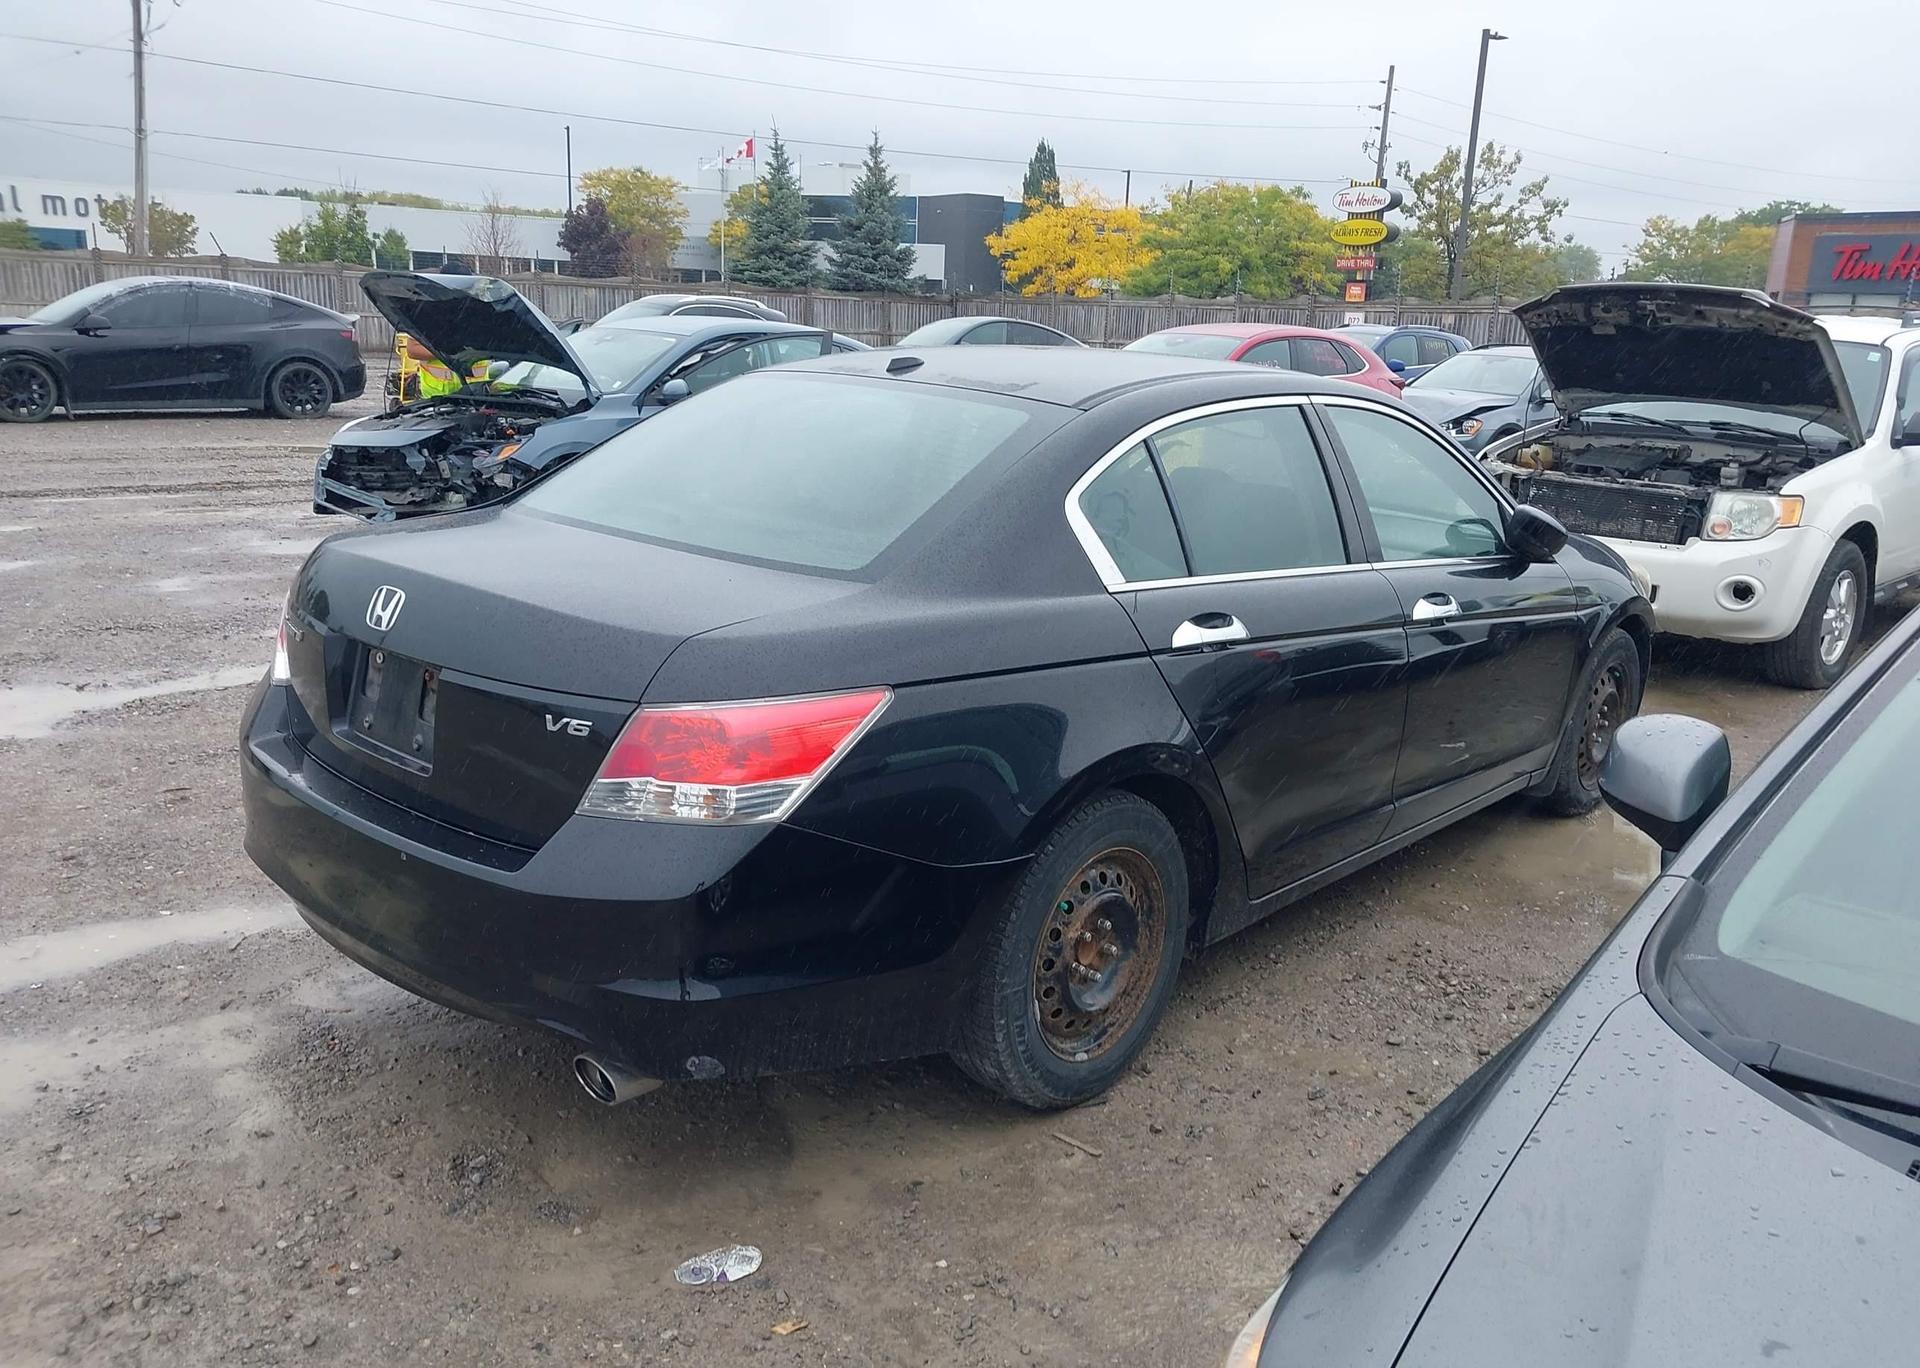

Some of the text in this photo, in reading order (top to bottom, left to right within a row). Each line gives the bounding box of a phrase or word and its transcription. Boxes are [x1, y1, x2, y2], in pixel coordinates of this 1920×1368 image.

[1338, 191, 1387, 208] Tim Hortons
[1334, 227, 1384, 237] ALWAYS FRESH
[1336, 259, 1374, 268] DRIVE THRU
[1831, 242, 1884, 281] Tim
[545, 714, 593, 737] V6
